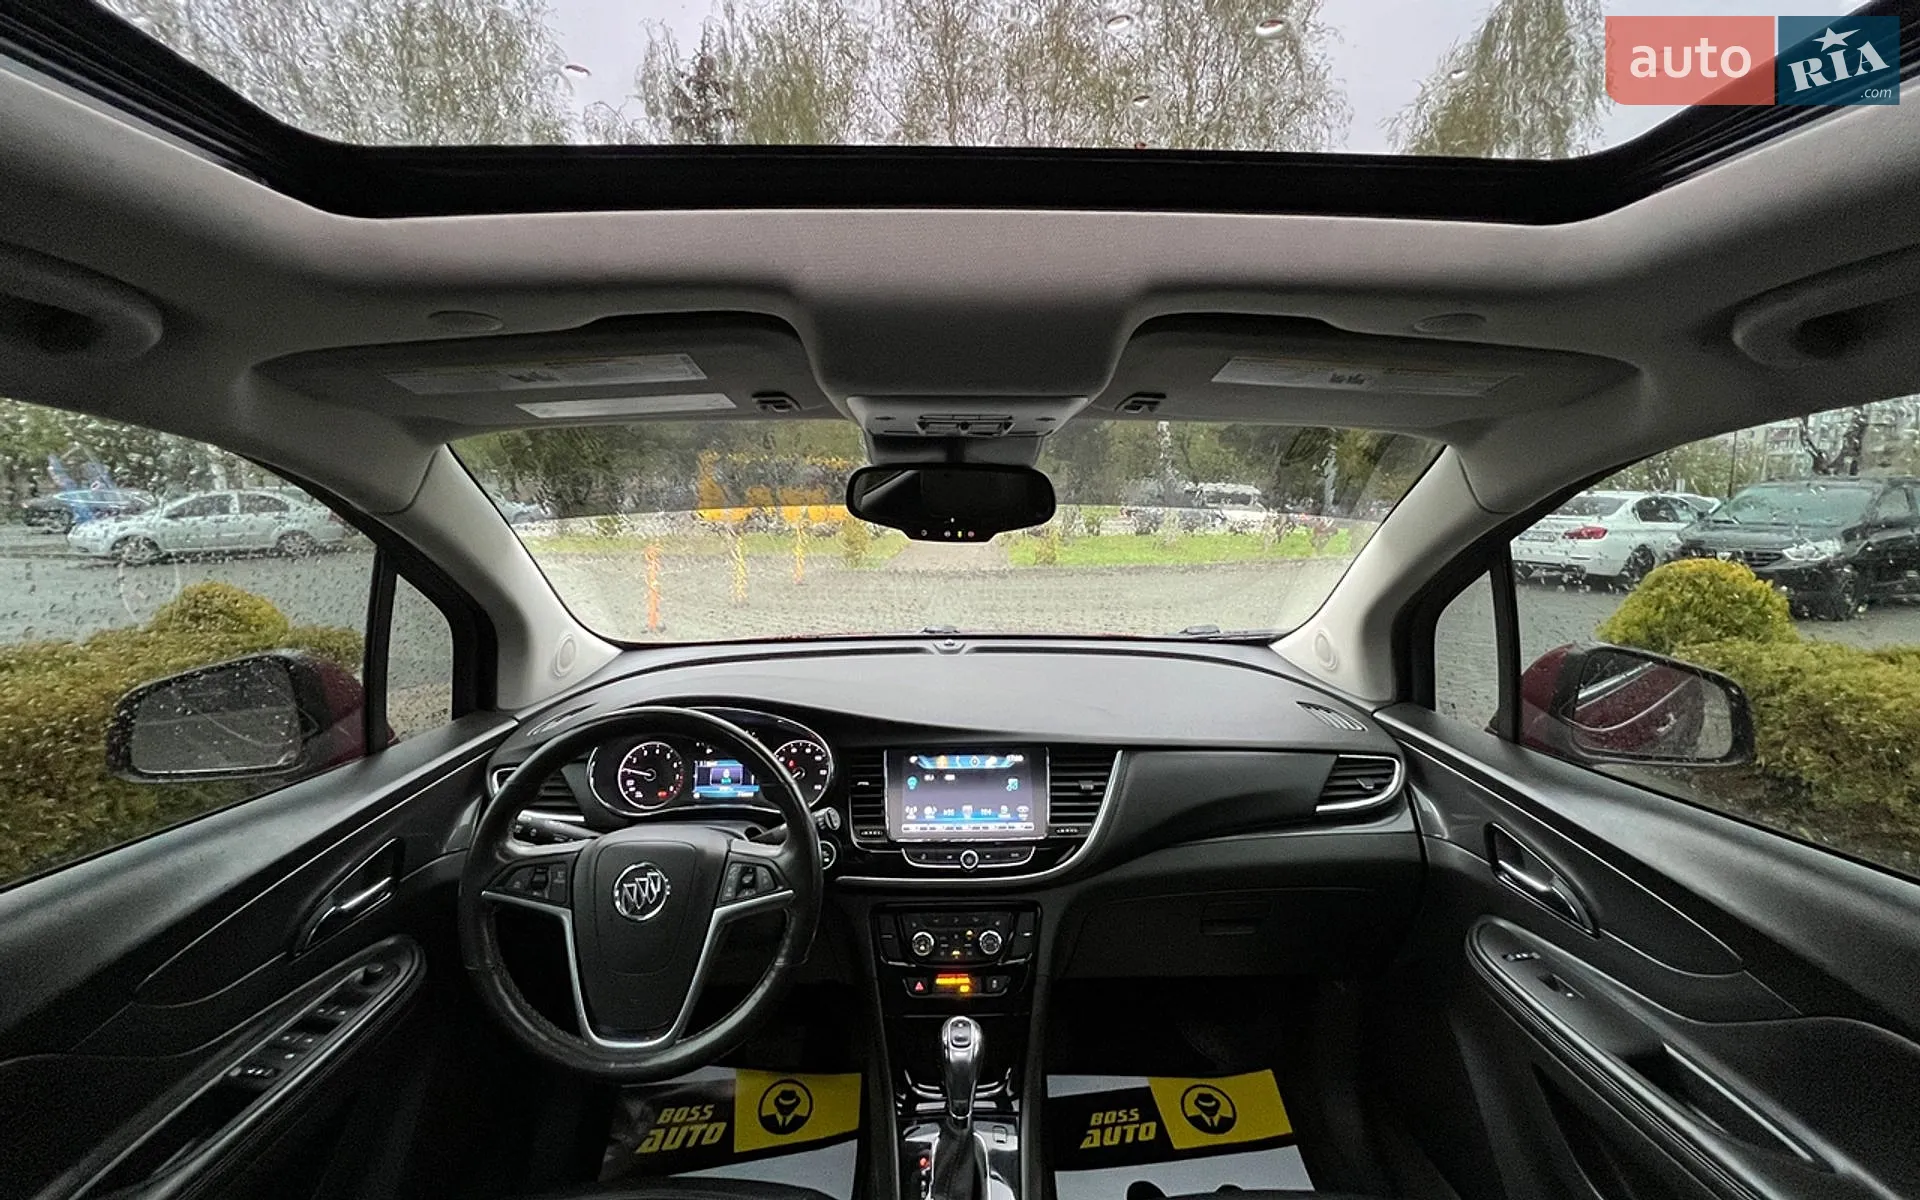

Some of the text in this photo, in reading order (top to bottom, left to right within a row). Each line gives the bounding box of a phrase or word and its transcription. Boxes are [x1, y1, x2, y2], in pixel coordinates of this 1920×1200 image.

[656, 1104, 715, 1124] BOSS
[1090, 1108, 1140, 1126] BOSS
[634, 1121, 728, 1154] AUTO
[1079, 1121, 1158, 1149] AUTO
